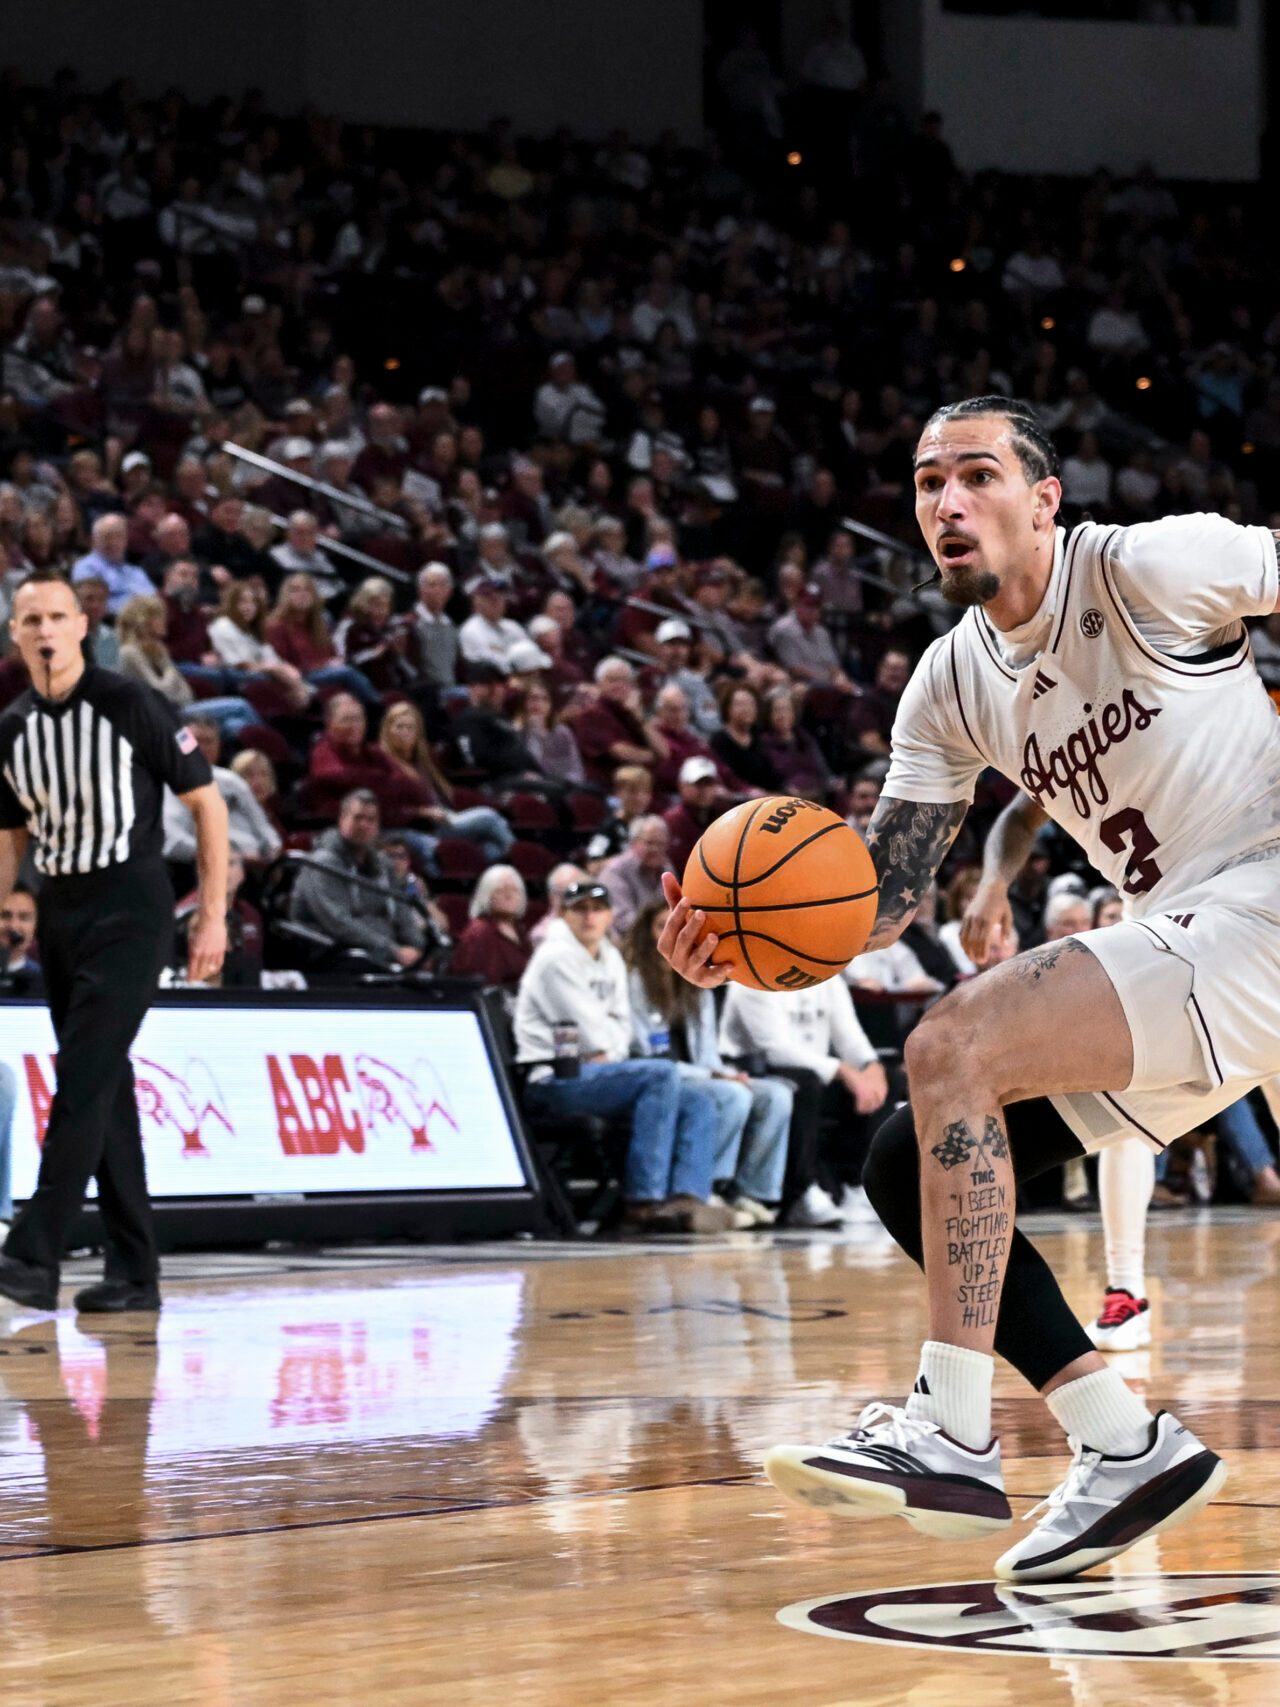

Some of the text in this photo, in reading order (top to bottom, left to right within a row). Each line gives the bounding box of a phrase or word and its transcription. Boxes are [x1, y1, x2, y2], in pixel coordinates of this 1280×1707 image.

[1081, 610, 1104, 637] SEC
[1020, 688, 1163, 819] Aggies
[265, 1054, 366, 1156] ABC
[969, 1168, 996, 1186] TMC
[967, 1184, 1006, 1213] BEEN
[944, 1211, 1009, 1239] FIGHTING
[946, 1236, 1007, 1266] BATTLES
[963, 1260, 999, 1284] UP A
[956, 1279, 1001, 1304] STEEP
